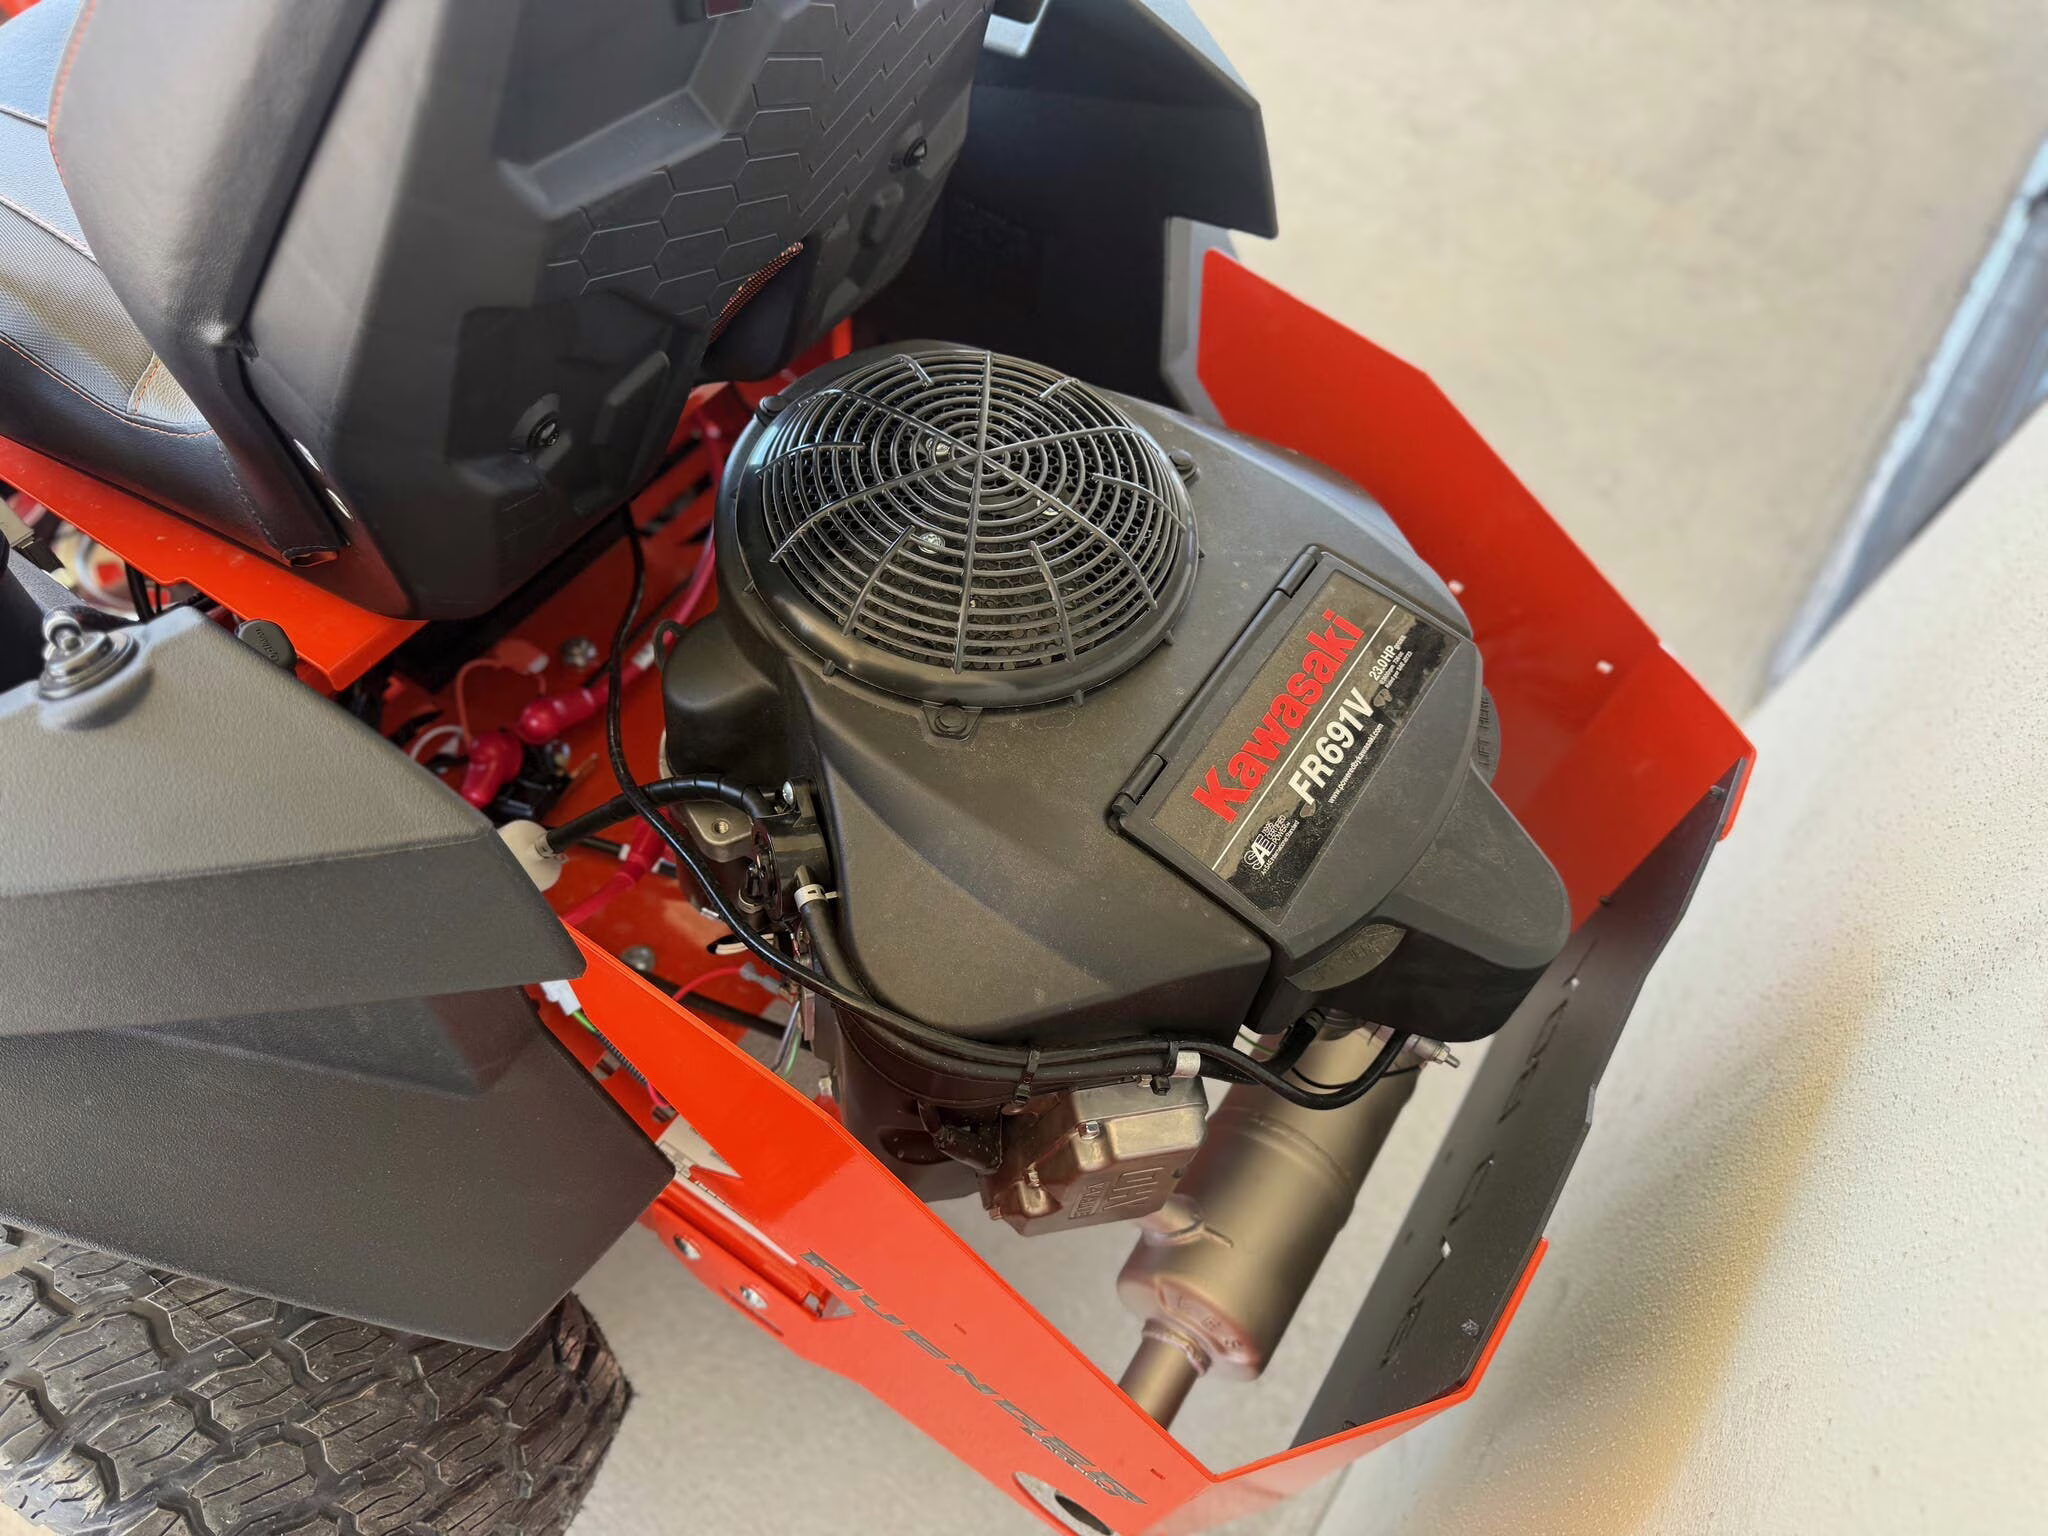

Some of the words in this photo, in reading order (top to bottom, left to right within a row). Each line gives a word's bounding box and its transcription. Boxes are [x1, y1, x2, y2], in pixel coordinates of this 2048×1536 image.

[1192, 609, 1365, 824] Kawasaki
[1288, 687, 1374, 805] FR691V
[1328, 723, 1384, 803] www.poweredbykawasaki.com
[1244, 833, 1277, 870] SAE
[1264, 859, 1273, 871] SAE
[1270, 838, 1288, 861] International
[1285, 820, 1300, 838] Standard
[1267, 814, 1286, 840] CERTIFIED
[799, 1249, 1148, 1504] AVENGER
